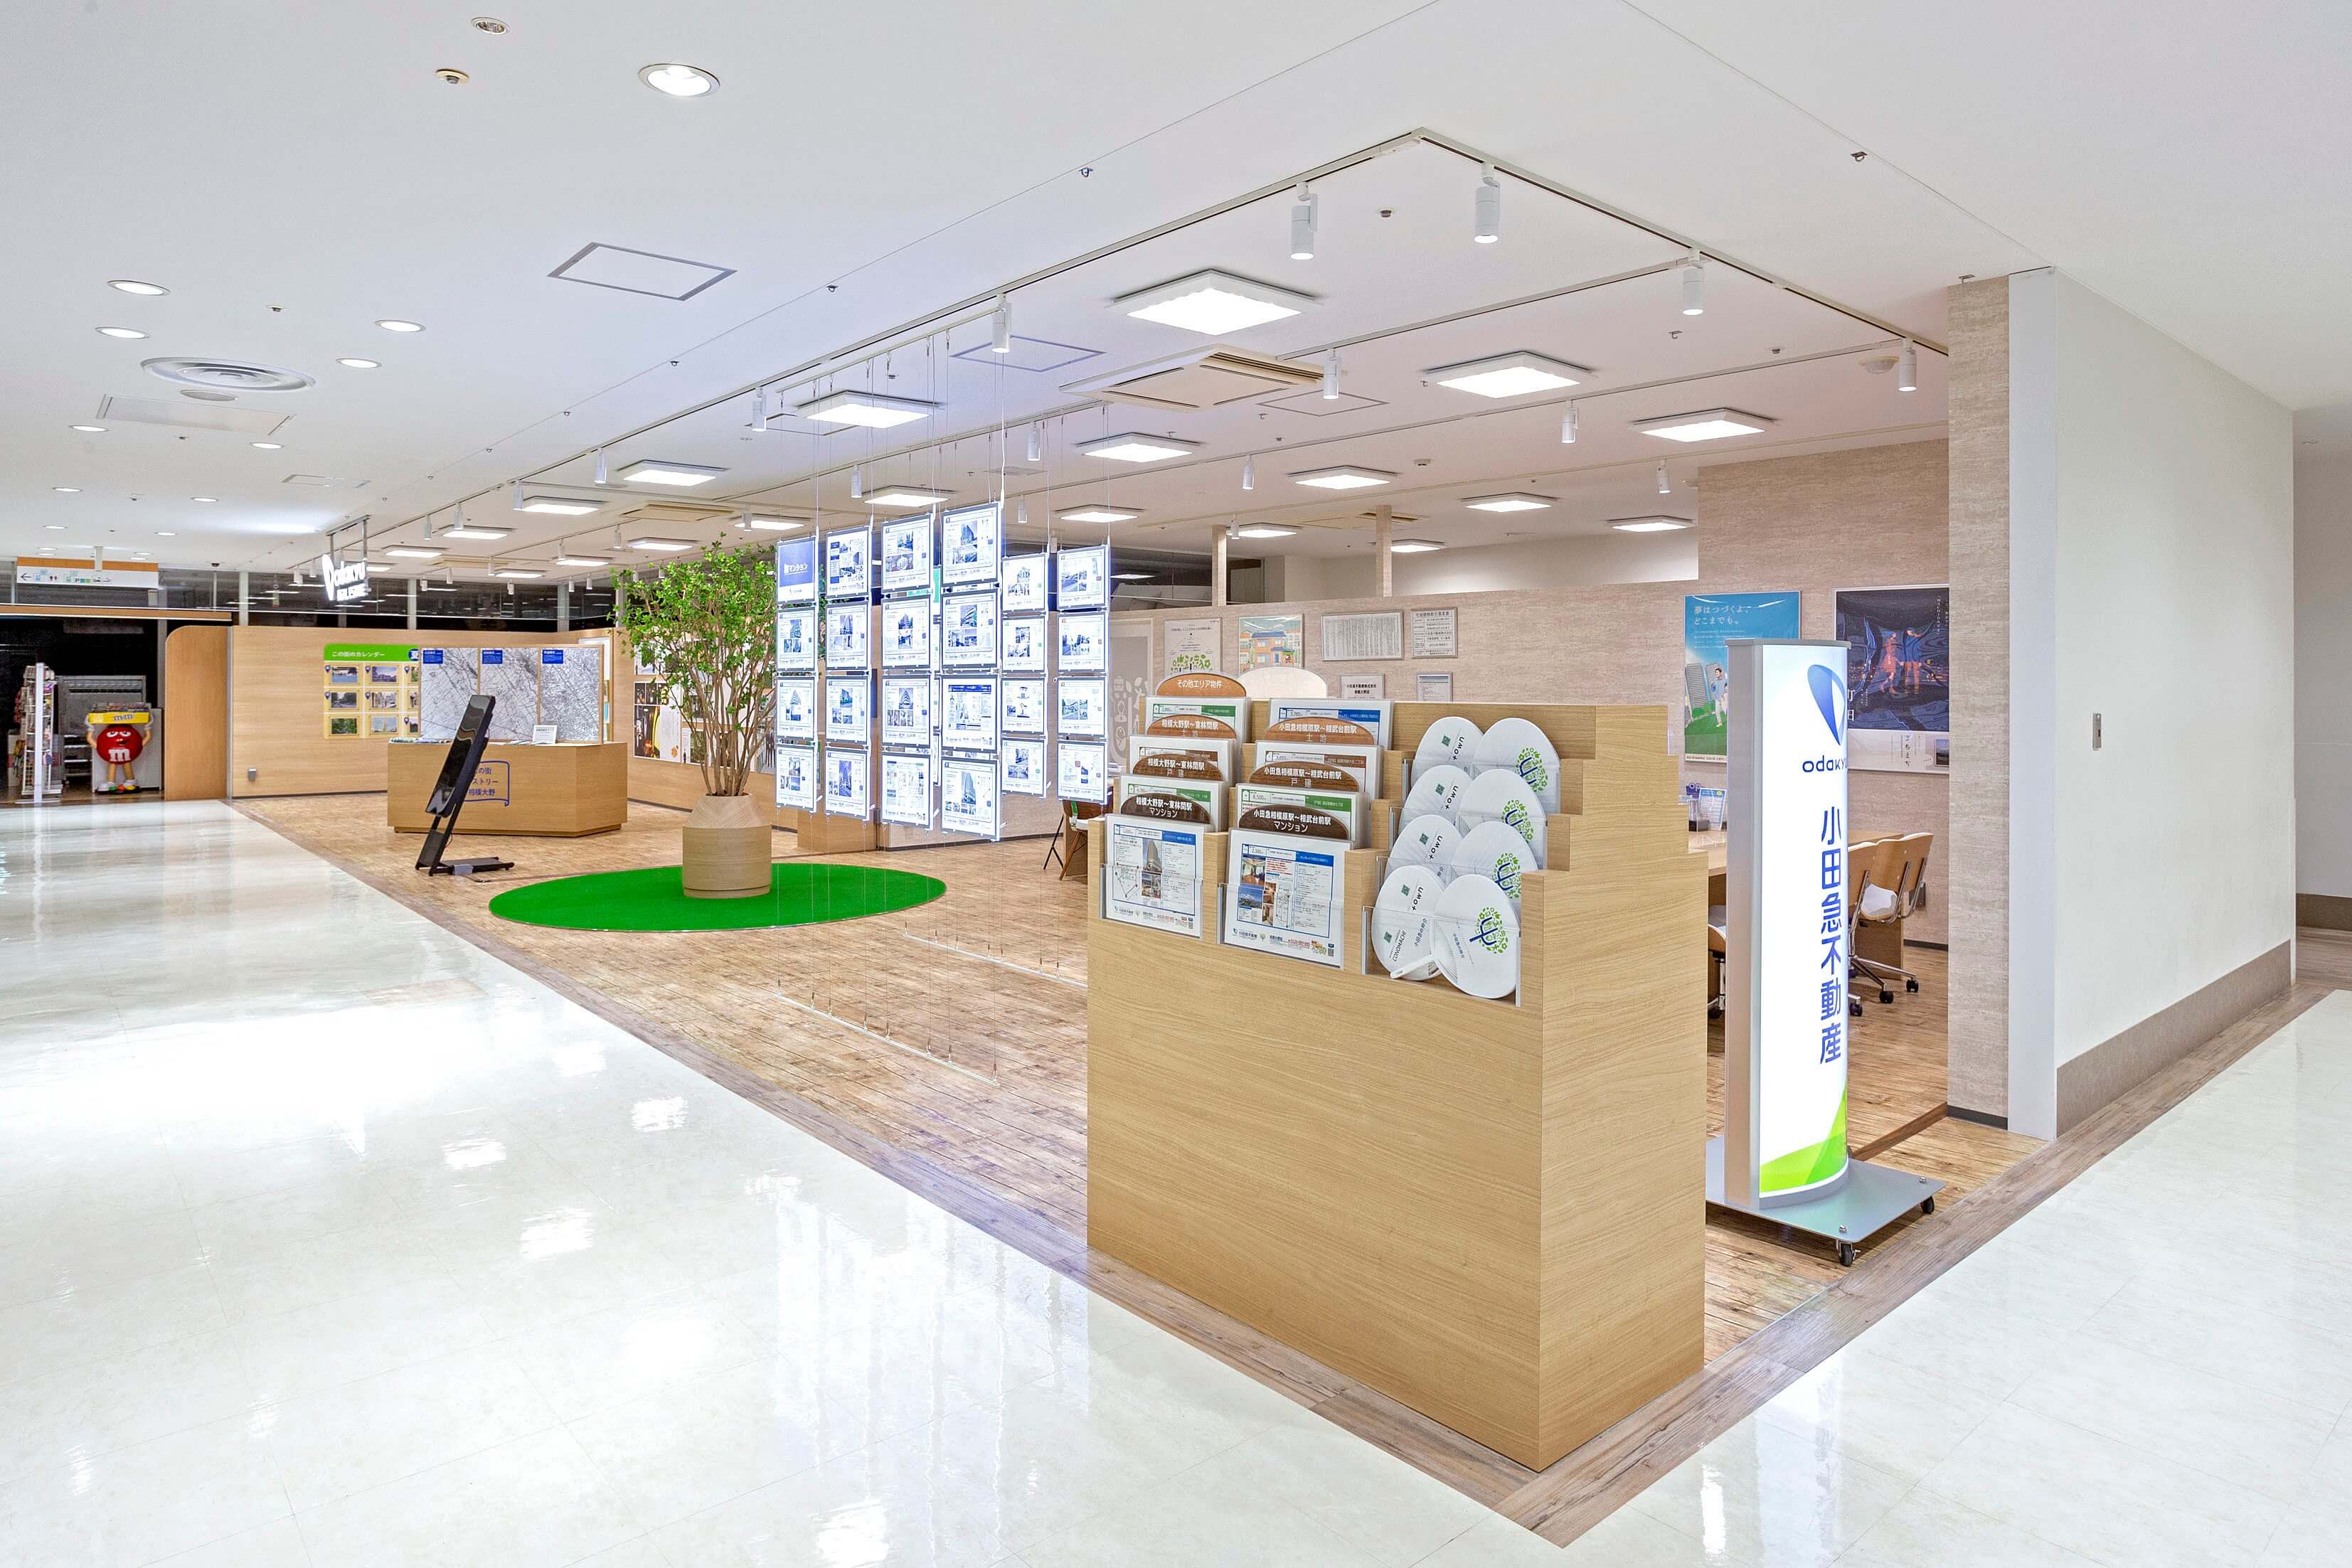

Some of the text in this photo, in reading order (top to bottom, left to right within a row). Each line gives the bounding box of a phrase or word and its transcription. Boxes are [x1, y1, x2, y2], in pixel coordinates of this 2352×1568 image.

[1177, 679, 1223, 689] その他エリア物件
[1149, 807, 1178, 818] マンション
[1274, 821, 1309, 833] マンション
[1814, 806, 1842, 1065] 小田急不動産
